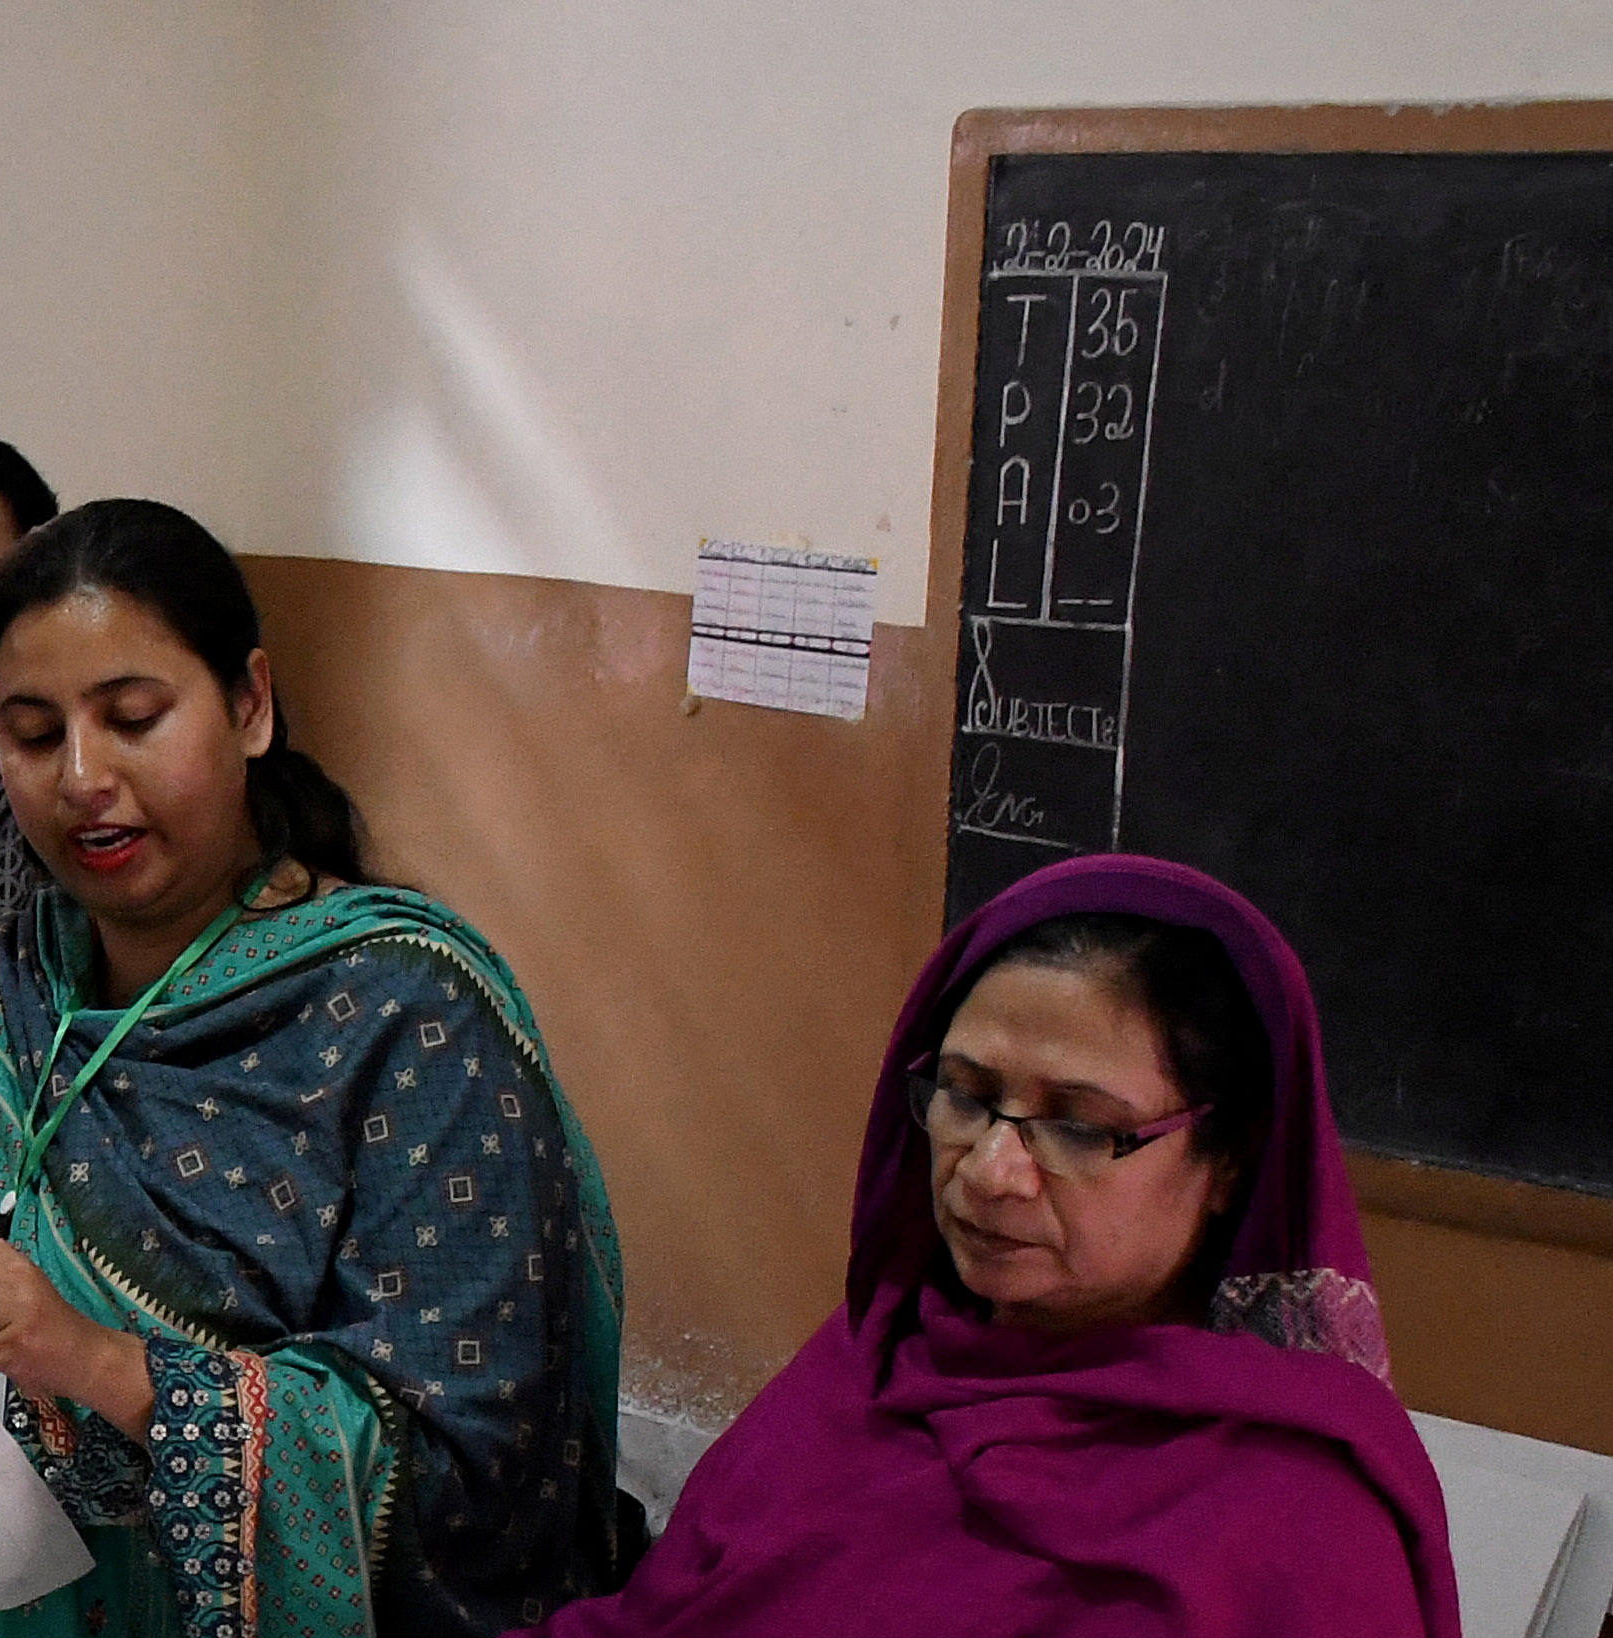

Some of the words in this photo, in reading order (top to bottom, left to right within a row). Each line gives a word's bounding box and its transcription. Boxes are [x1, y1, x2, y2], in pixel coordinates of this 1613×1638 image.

[1006, 294, 1047, 366] T
[1081, 287, 1139, 358] 35
[999, 381, 1031, 448] P
[1074, 381, 1135, 444] 32
[997, 455, 1030, 526] A
[1068, 482, 1120, 534] 03
[987, 538, 1028, 608] L
